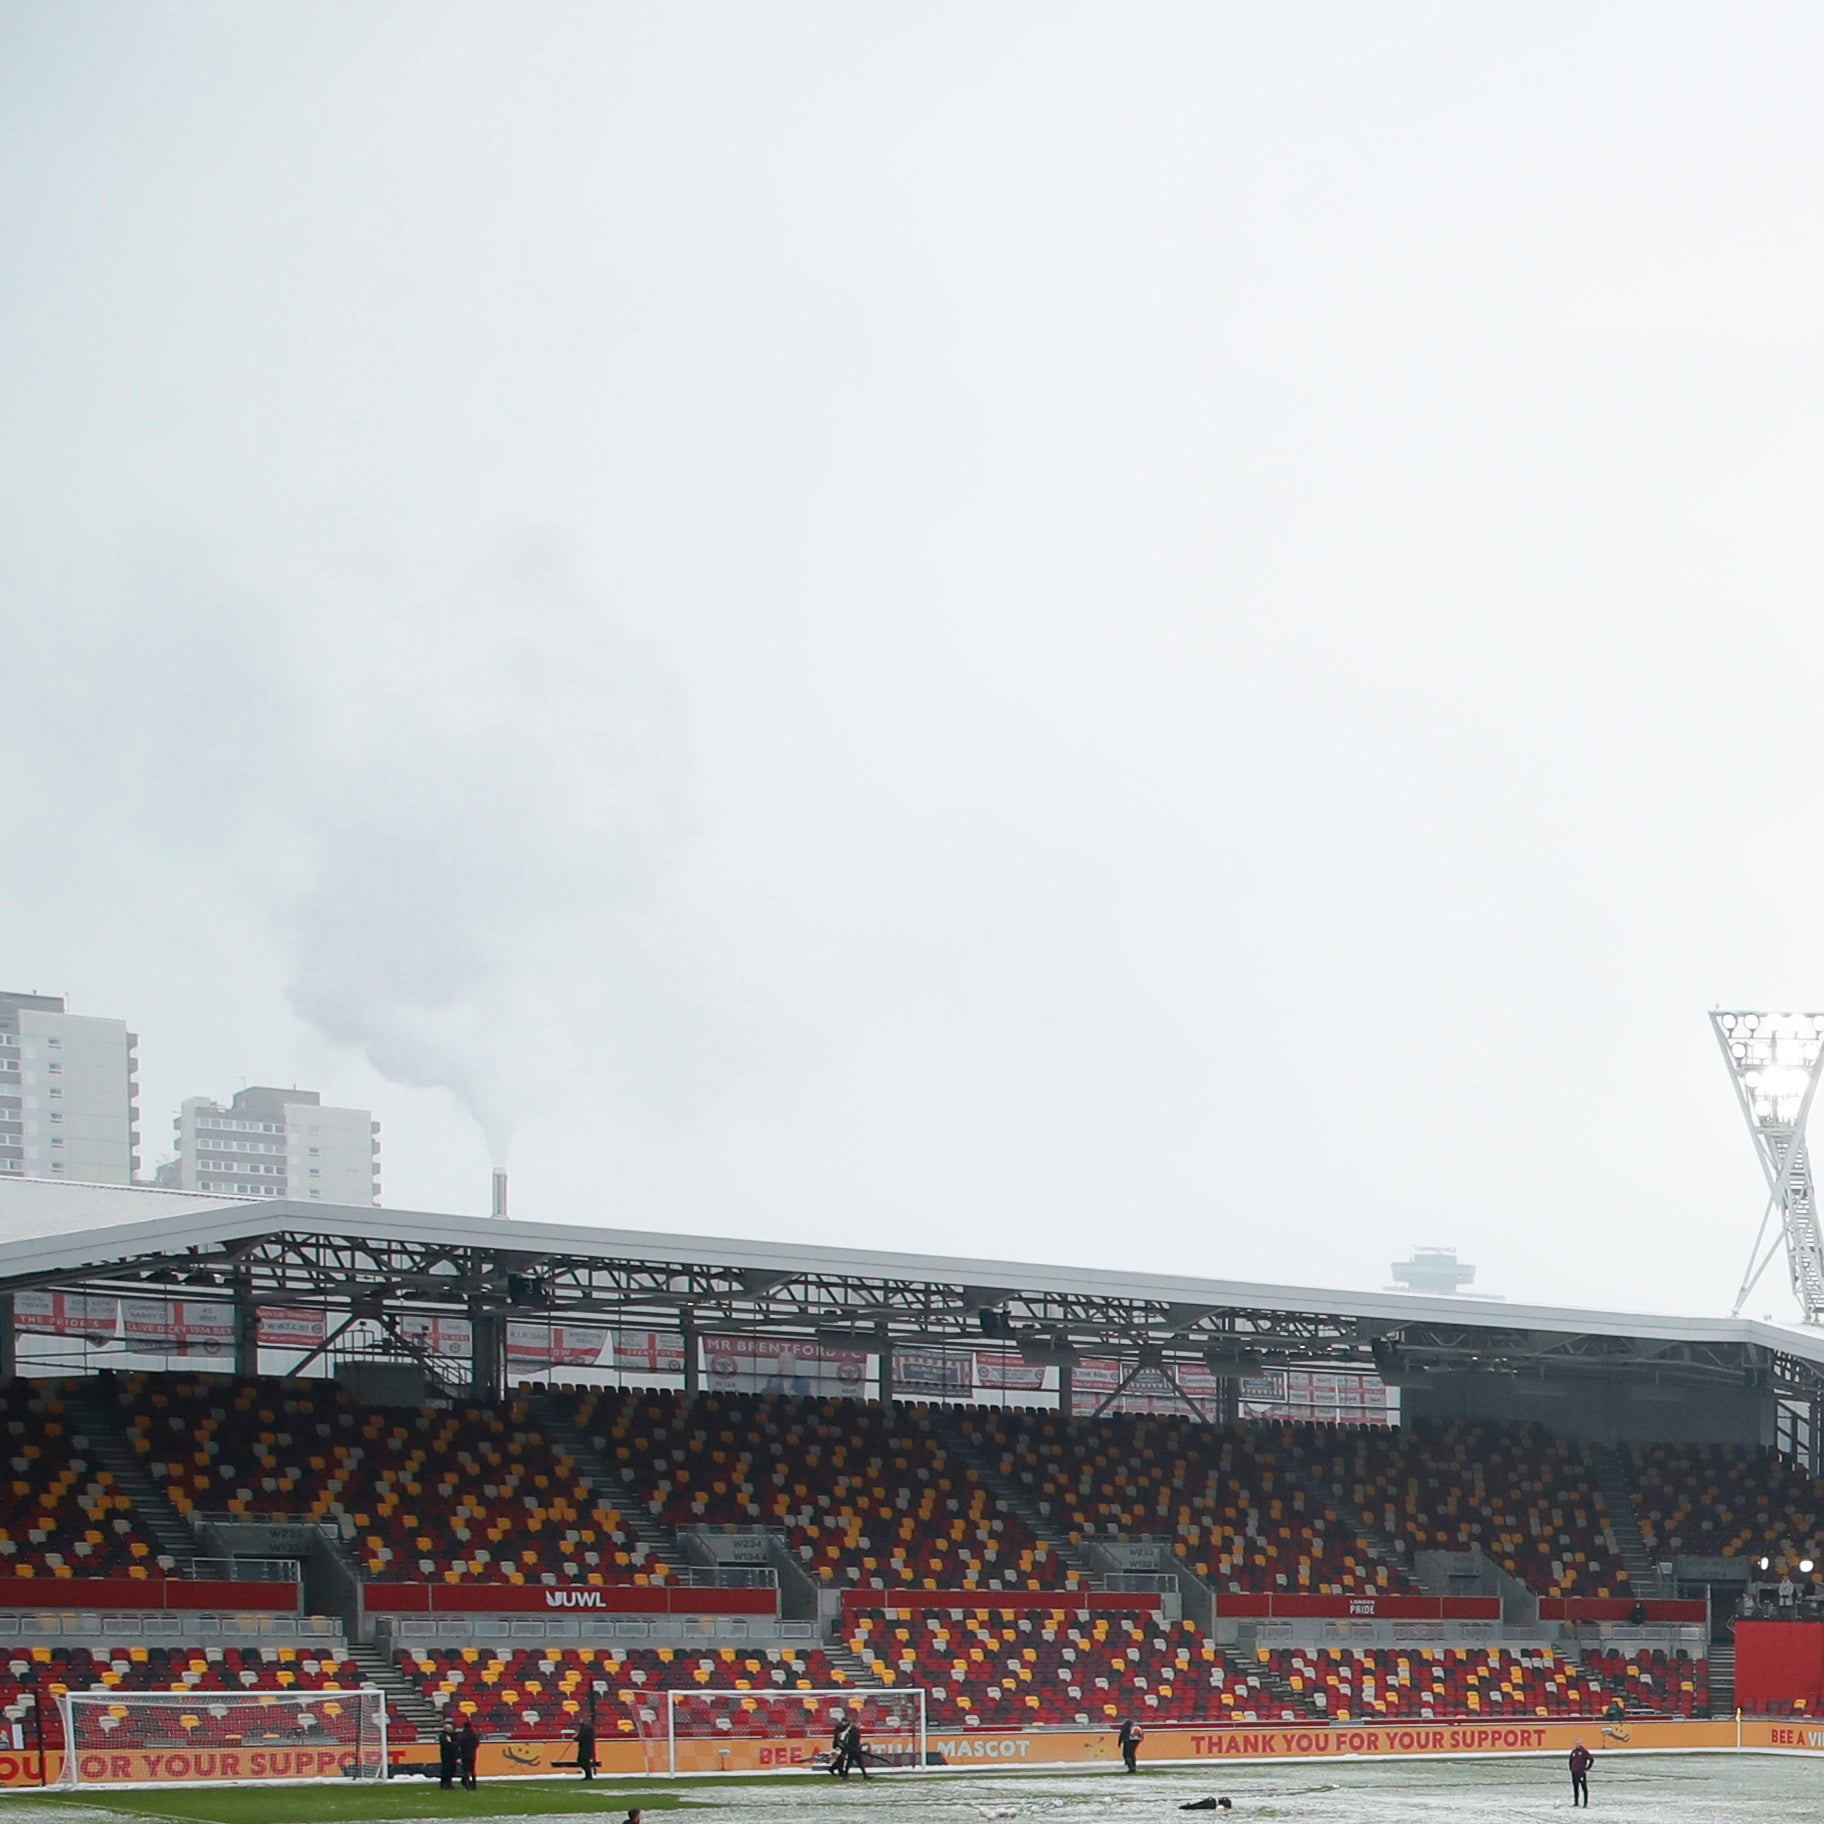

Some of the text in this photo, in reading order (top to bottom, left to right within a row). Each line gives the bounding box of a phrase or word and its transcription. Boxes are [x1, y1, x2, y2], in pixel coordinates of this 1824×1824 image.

[707, 1340, 731, 1351] MR
[1190, 1729, 1547, 1755] THANK YOU FOR YOUR SUPPORT
[1771, 1729, 1794, 1744] BEE
[1796, 1731, 1805, 1745] A
